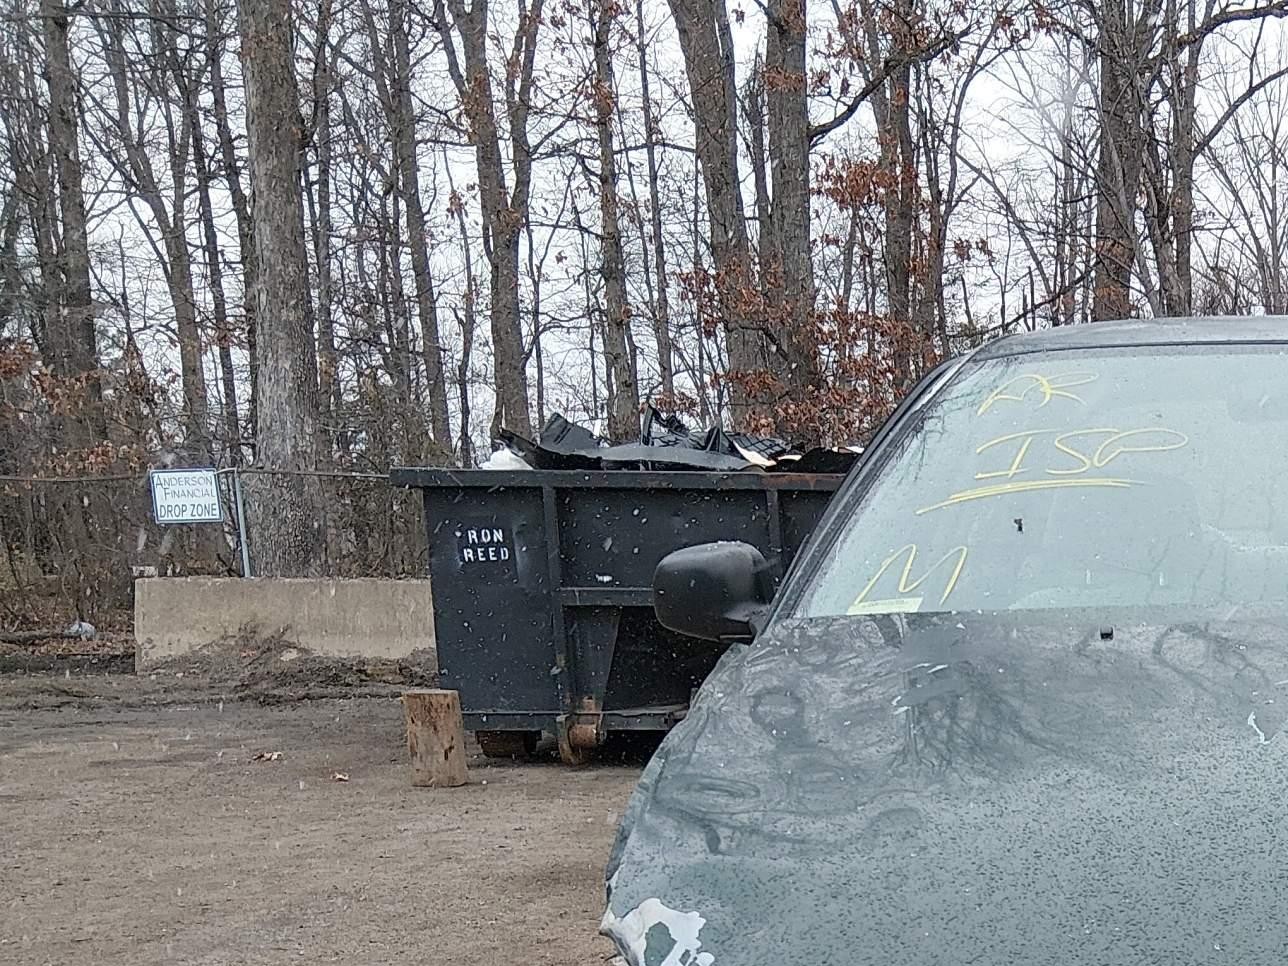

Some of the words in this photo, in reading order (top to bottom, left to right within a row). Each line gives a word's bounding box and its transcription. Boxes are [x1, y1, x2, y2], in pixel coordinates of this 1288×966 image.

[155, 474, 213, 488] ANDERSON
[163, 487, 216, 501] FINANCIAL
[159, 504, 188, 518] DROP
[190, 503, 217, 517] ZONE
[467, 528, 503, 544] RON
[463, 547, 509, 562] REED
